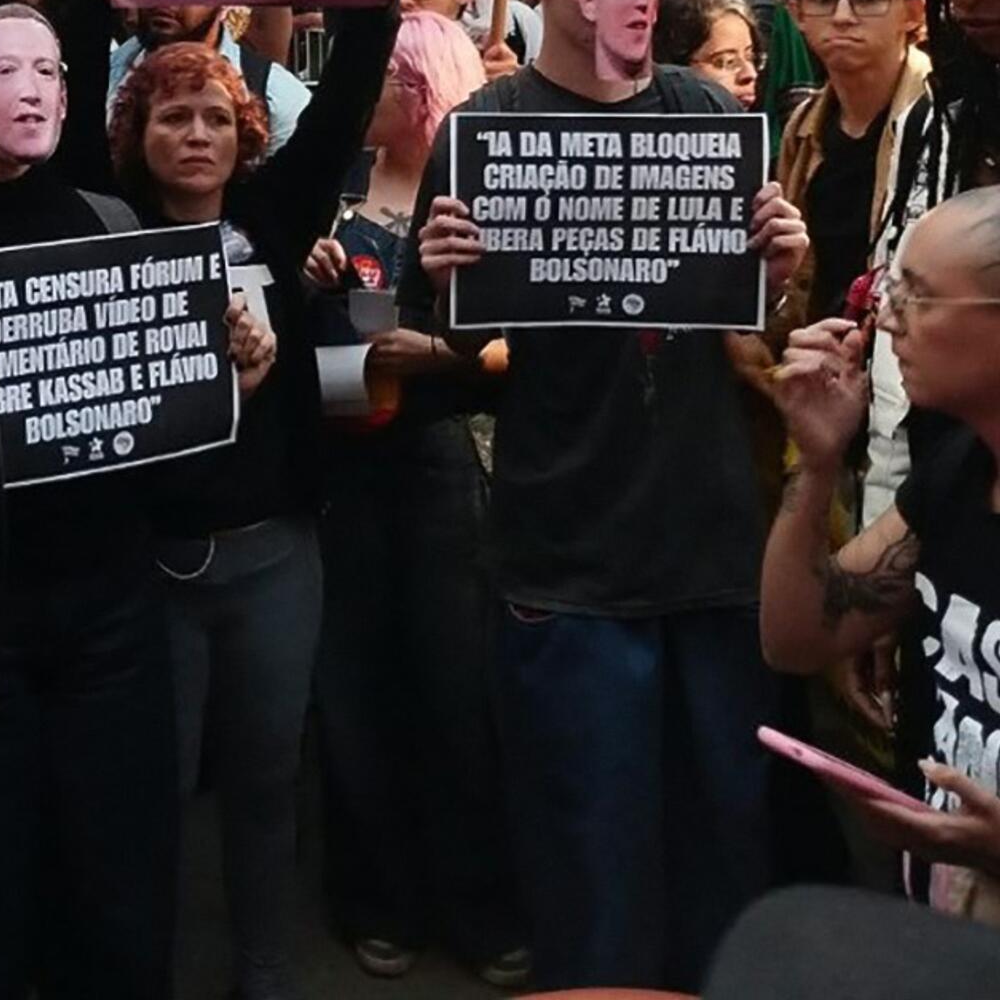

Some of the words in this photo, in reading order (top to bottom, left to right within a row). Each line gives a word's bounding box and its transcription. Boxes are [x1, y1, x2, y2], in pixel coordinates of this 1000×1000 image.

[520, 131, 551, 157] DA
[560, 132, 623, 158] META
[630, 132, 742, 161] BLOQUEIA
[484, 160, 586, 196] CRIAÇÃO
[594, 165, 623, 190] DE
[630, 165, 735, 190] IMAGENS
[473, 196, 526, 221] COM
[535, 197, 551, 221] O
[559, 197, 624, 221] NOME
[631, 197, 660, 221] DE
[667, 197, 722, 221] LULA
[730, 197, 744, 221] E
[479, 227, 543, 251] IBERA
[552, 227, 624, 256] PEÇAS
[632, 228, 660, 251] DE
[668, 223, 747, 254] FLÁVIO
[25, 266, 124, 305] CENSURA
[130, 254, 203, 288] FÓRUM
[209, 253, 222, 280] E
[95, 296, 155, 328] VÍDEO
[163, 291, 188, 319] DE
[113, 331, 138, 359] DE
[145, 320, 207, 355] ROVAI
[38, 369, 124, 407] KASSAB
[131, 363, 143, 391] E
[149, 352, 218, 388] FLÁVIO
[26, 395, 162, 444] BOLSONARO”
